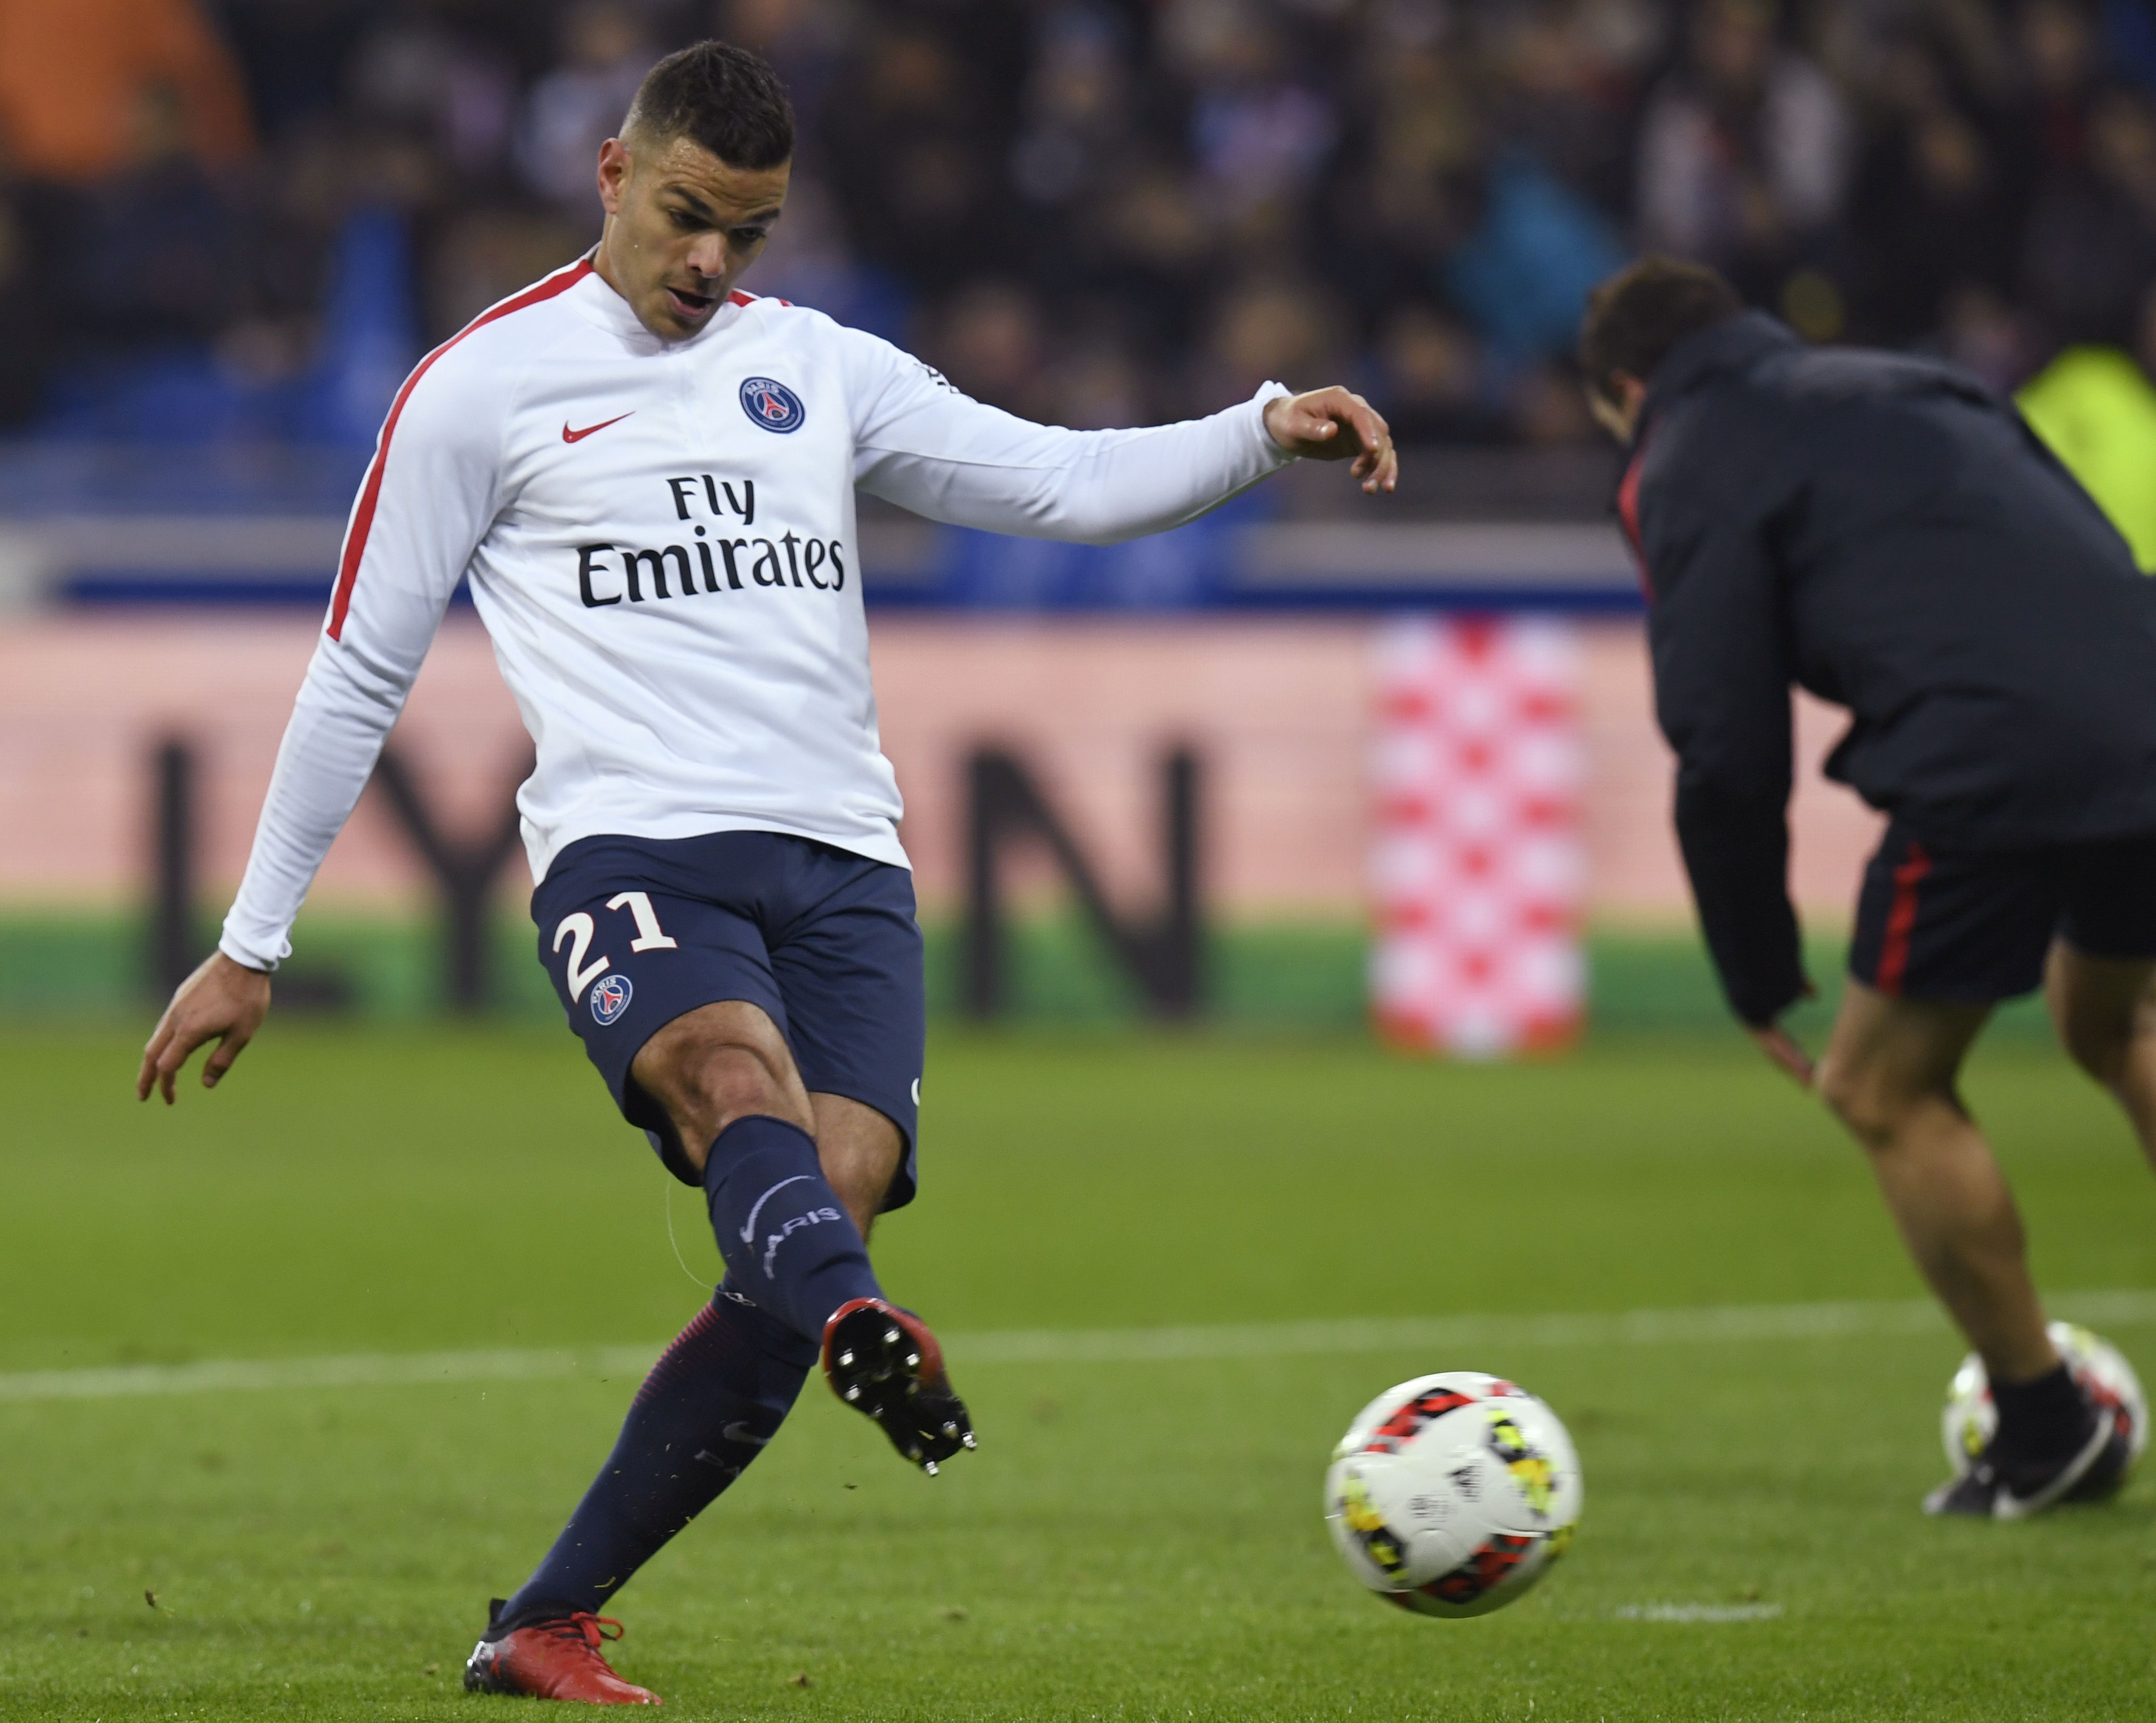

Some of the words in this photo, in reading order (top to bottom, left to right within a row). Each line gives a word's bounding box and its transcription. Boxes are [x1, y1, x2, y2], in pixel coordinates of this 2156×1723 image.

[746, 381, 780, 396] PARIS
[666, 474, 754, 525] Fly
[576, 525, 844, 608] Emirates
[152, 736, 1207, 1020] LYN
[551, 891, 678, 1004] 21
[592, 978, 617, 1004] PARIS
